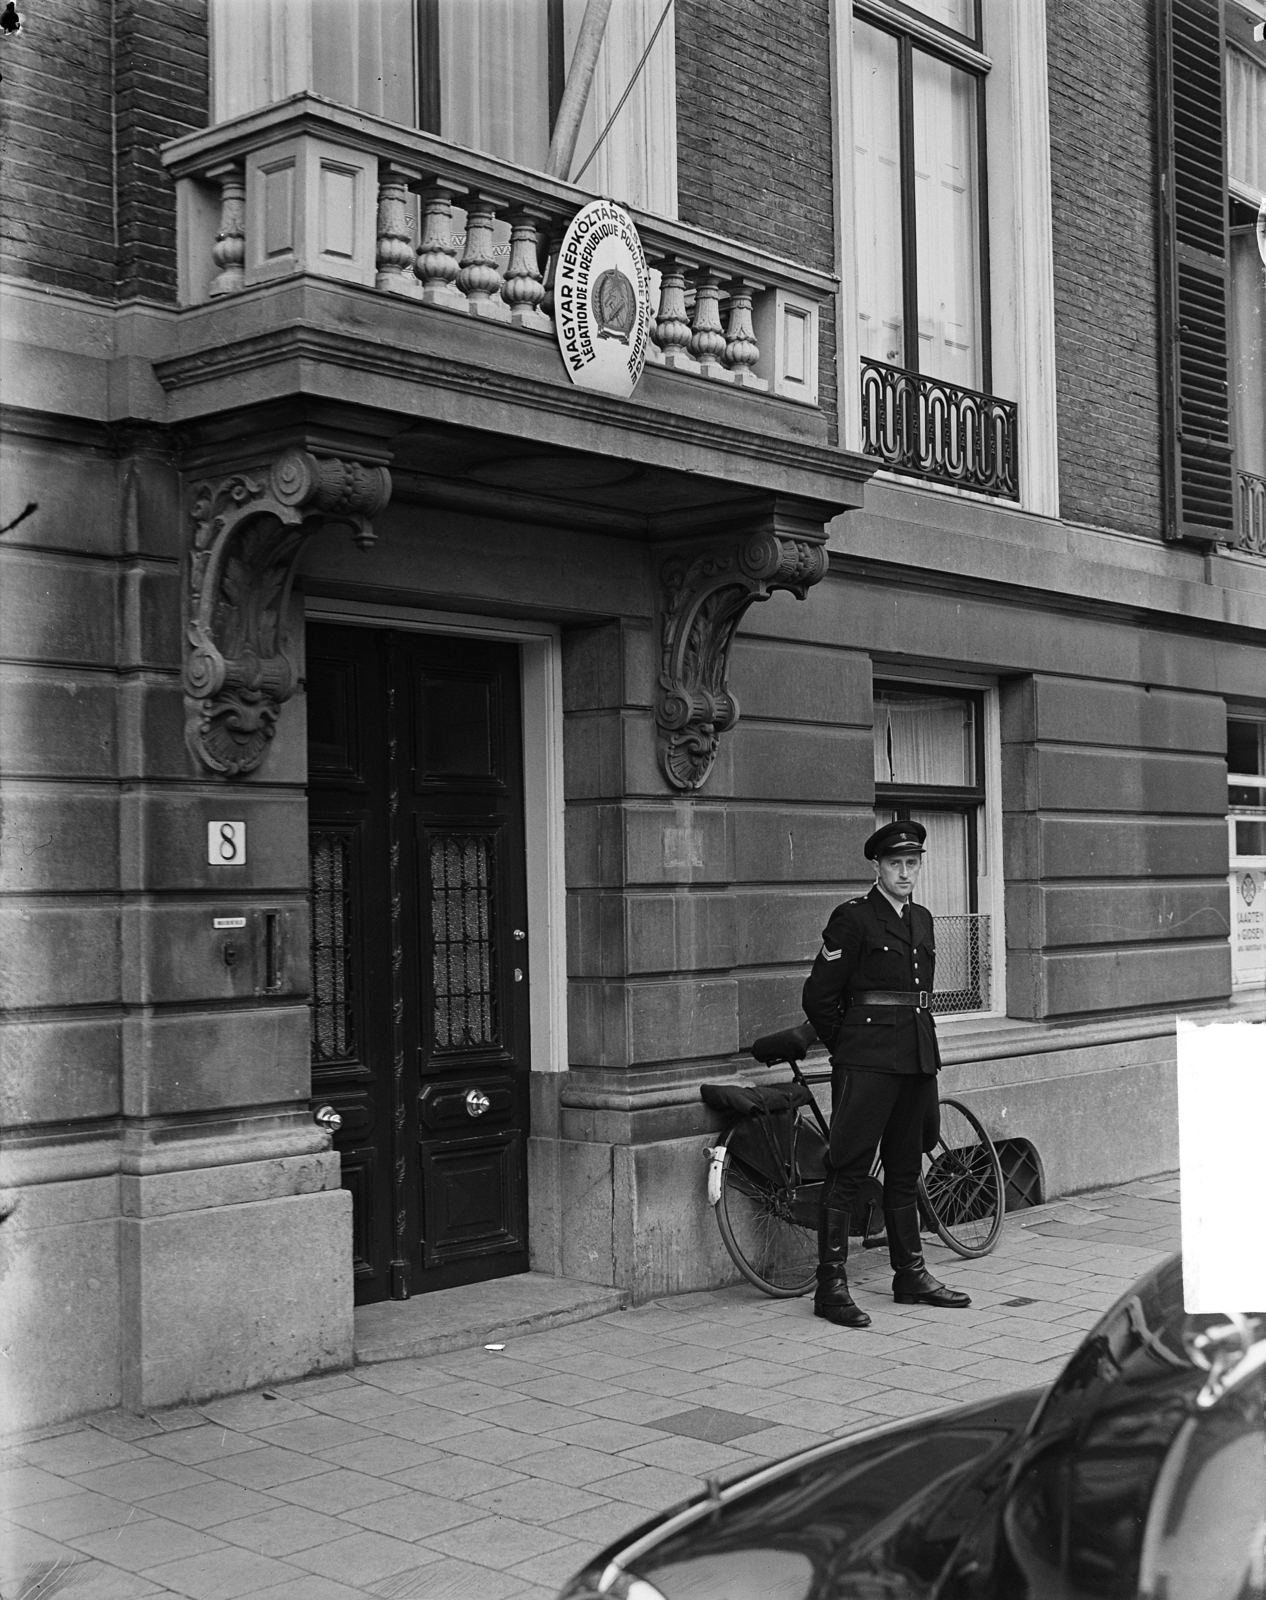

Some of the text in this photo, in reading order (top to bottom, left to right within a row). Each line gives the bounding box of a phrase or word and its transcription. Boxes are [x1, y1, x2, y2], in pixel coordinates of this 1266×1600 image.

[561, 285, 584, 371] MAGYAR
[576, 223, 645, 373] LÉGATION DE LA RÉPUBLIQUE POPULAIRE HONGROISE
[220, 823, 237, 860] 8
